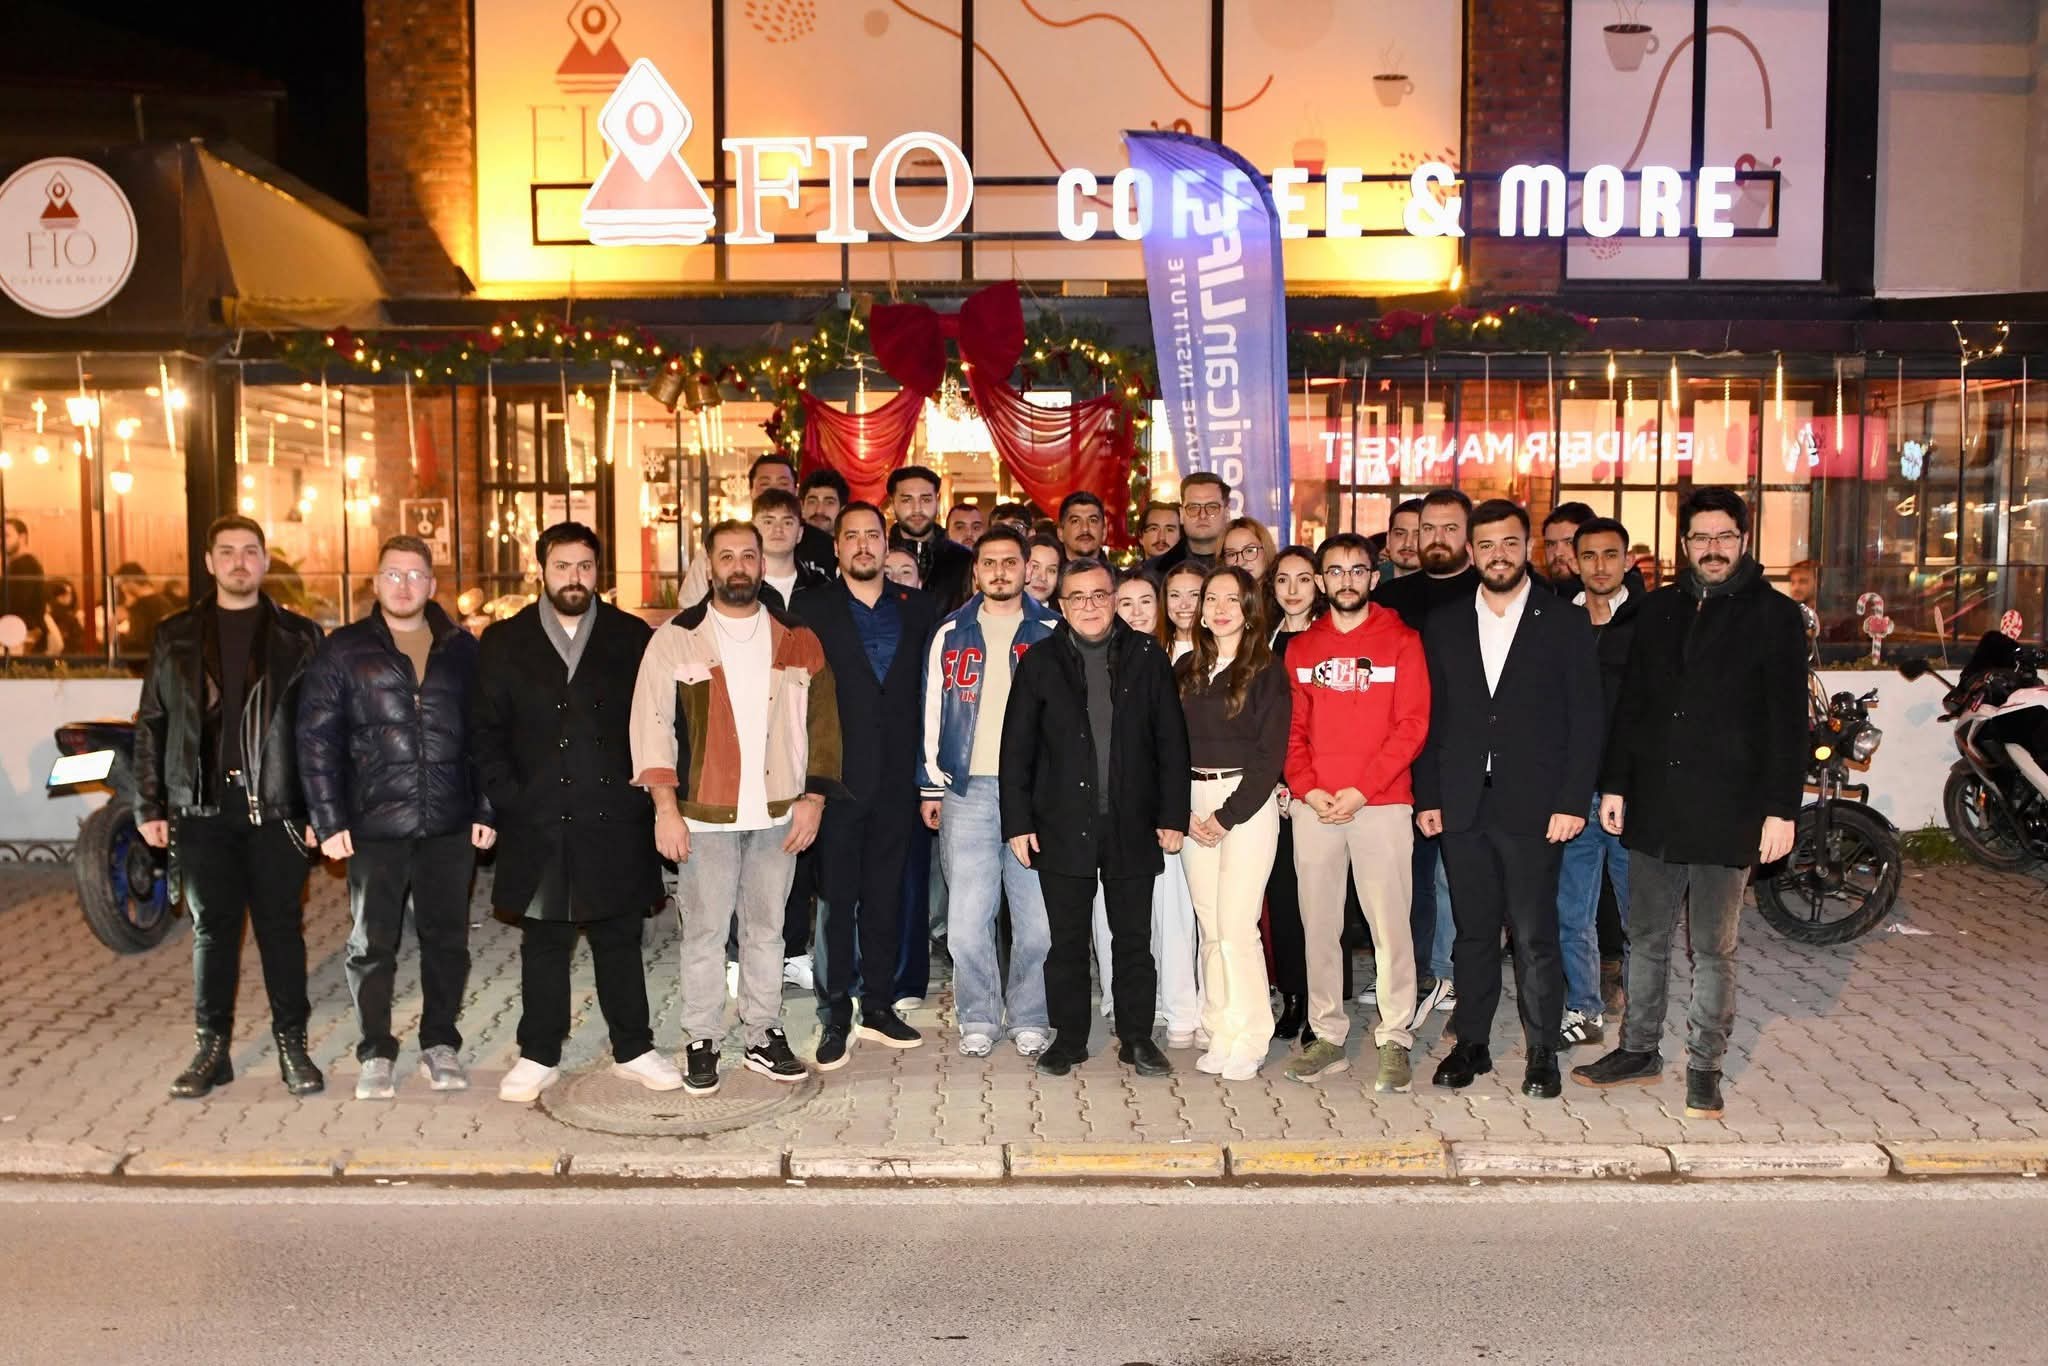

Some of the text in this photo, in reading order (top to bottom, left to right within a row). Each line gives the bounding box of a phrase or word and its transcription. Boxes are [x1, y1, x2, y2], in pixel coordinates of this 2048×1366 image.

[527, 104, 609, 180] FI
[722, 131, 1736, 242] FIO COFFEE & MORE
[27, 231, 96, 269] FIO
